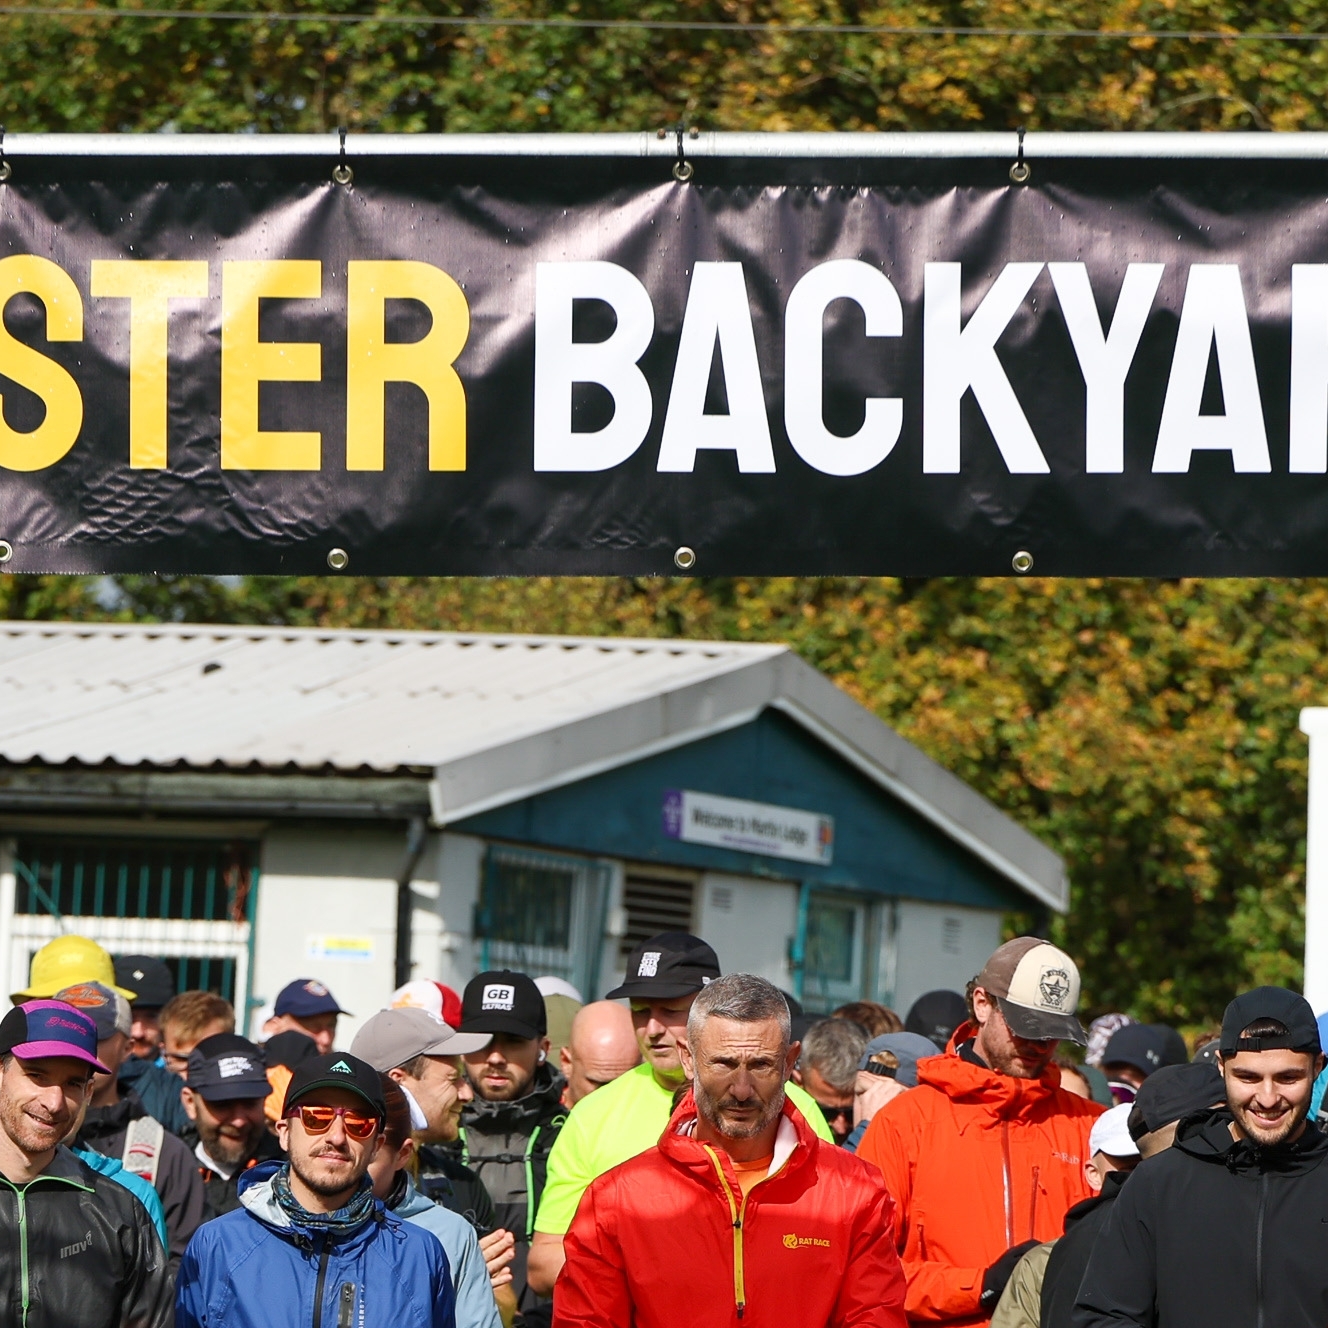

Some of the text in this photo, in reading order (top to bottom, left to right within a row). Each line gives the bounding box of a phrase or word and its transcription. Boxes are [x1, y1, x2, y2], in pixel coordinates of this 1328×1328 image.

[487, 989, 510, 1000] GB
[798, 1237, 830, 1247] RAT RACE
